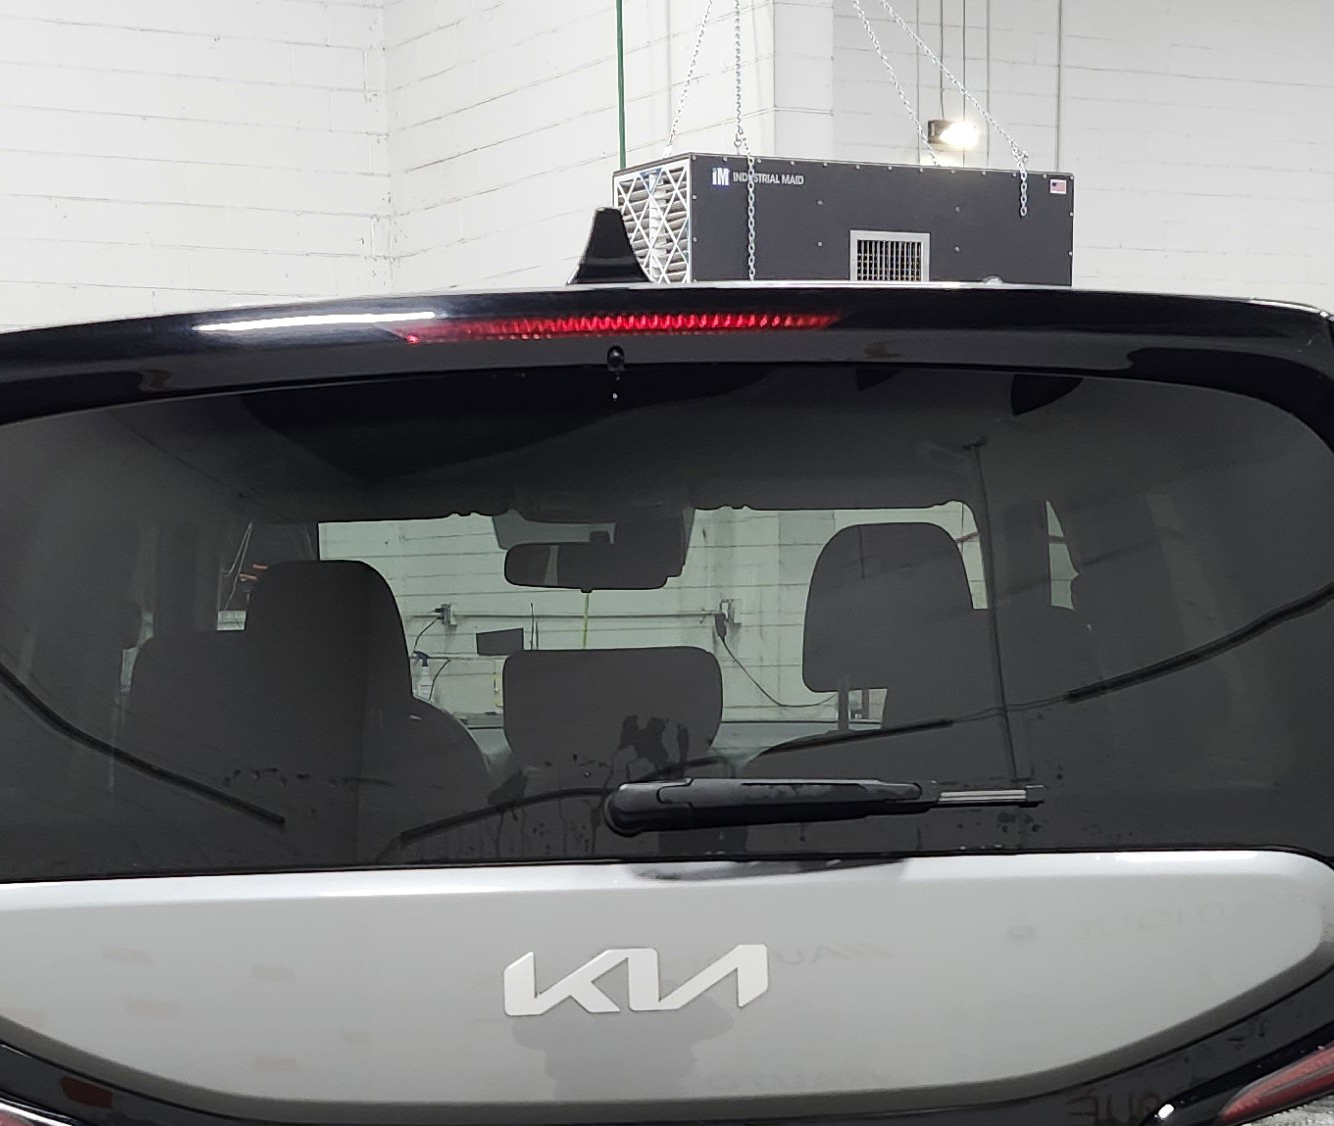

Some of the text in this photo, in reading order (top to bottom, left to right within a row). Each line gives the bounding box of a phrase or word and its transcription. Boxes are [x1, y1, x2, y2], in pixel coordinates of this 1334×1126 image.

[733, 171, 780, 184] INDSTRIAL
[781, 174, 805, 185] MAID
[504, 943, 769, 1016] KIA
